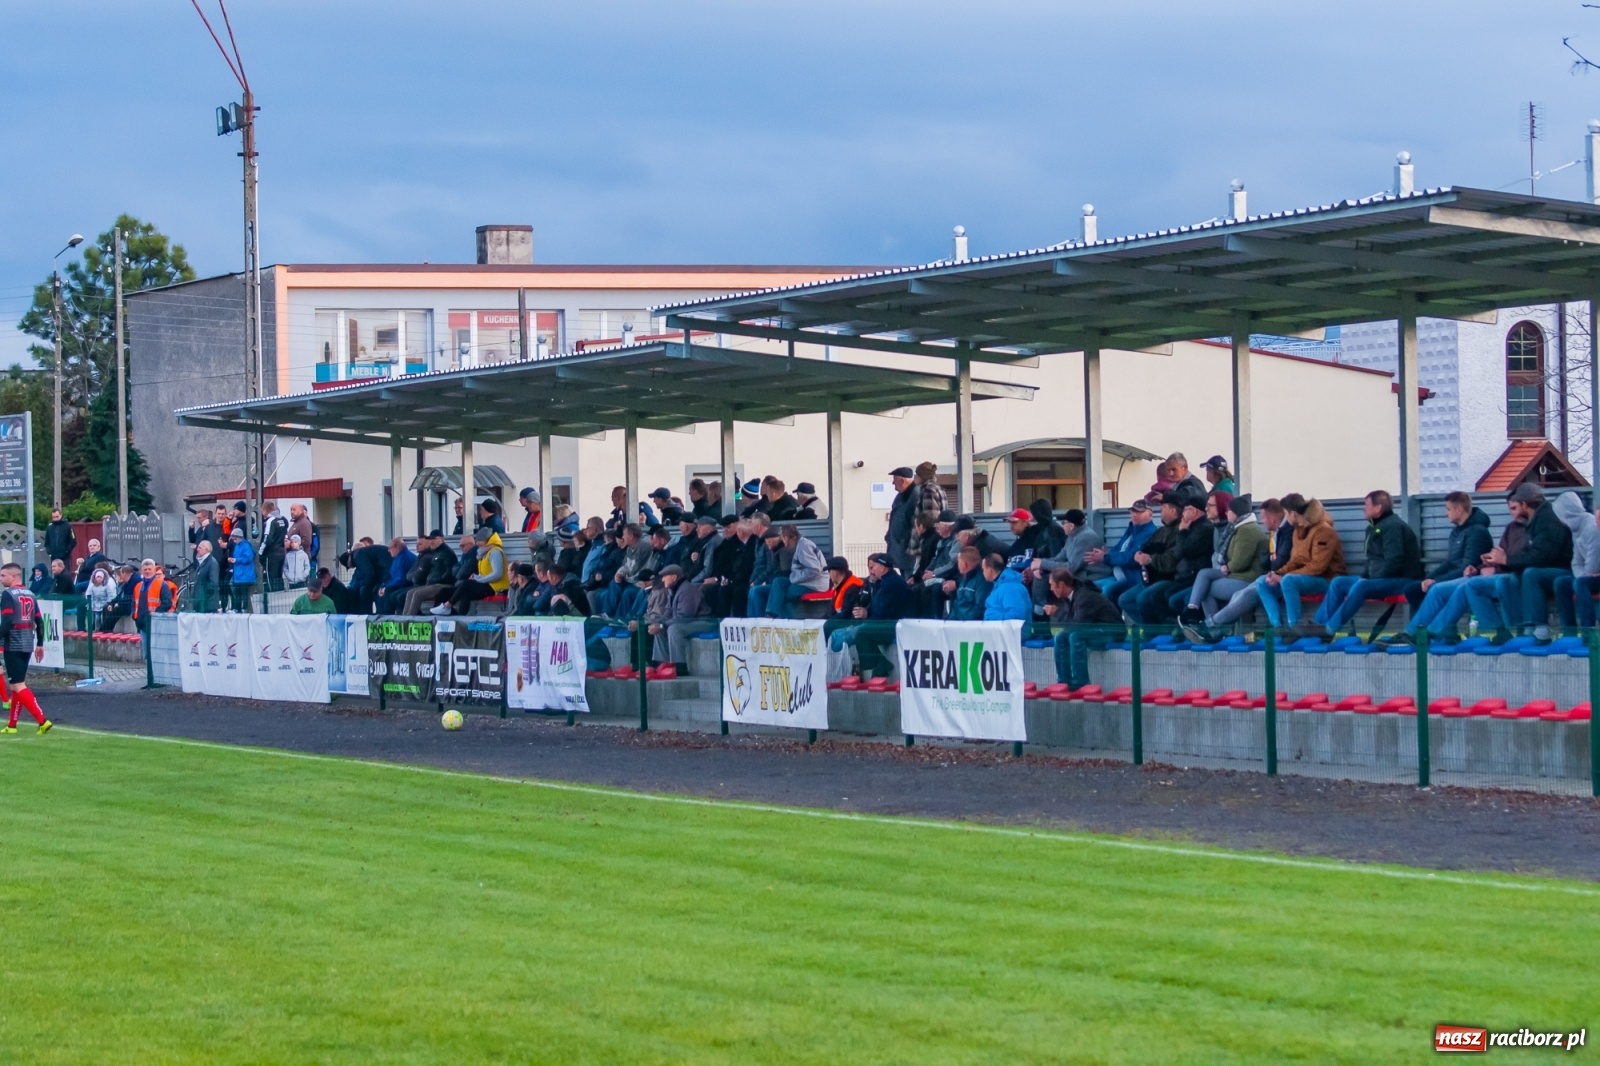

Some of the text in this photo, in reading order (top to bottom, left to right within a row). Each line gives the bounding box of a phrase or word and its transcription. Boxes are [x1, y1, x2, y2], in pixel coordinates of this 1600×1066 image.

[483, 314, 520, 324] KUCHENN
[351, 366, 379, 376] MEBLE
[904, 642, 1010, 694] KERAKOLL
[759, 662, 813, 714] FUN club
